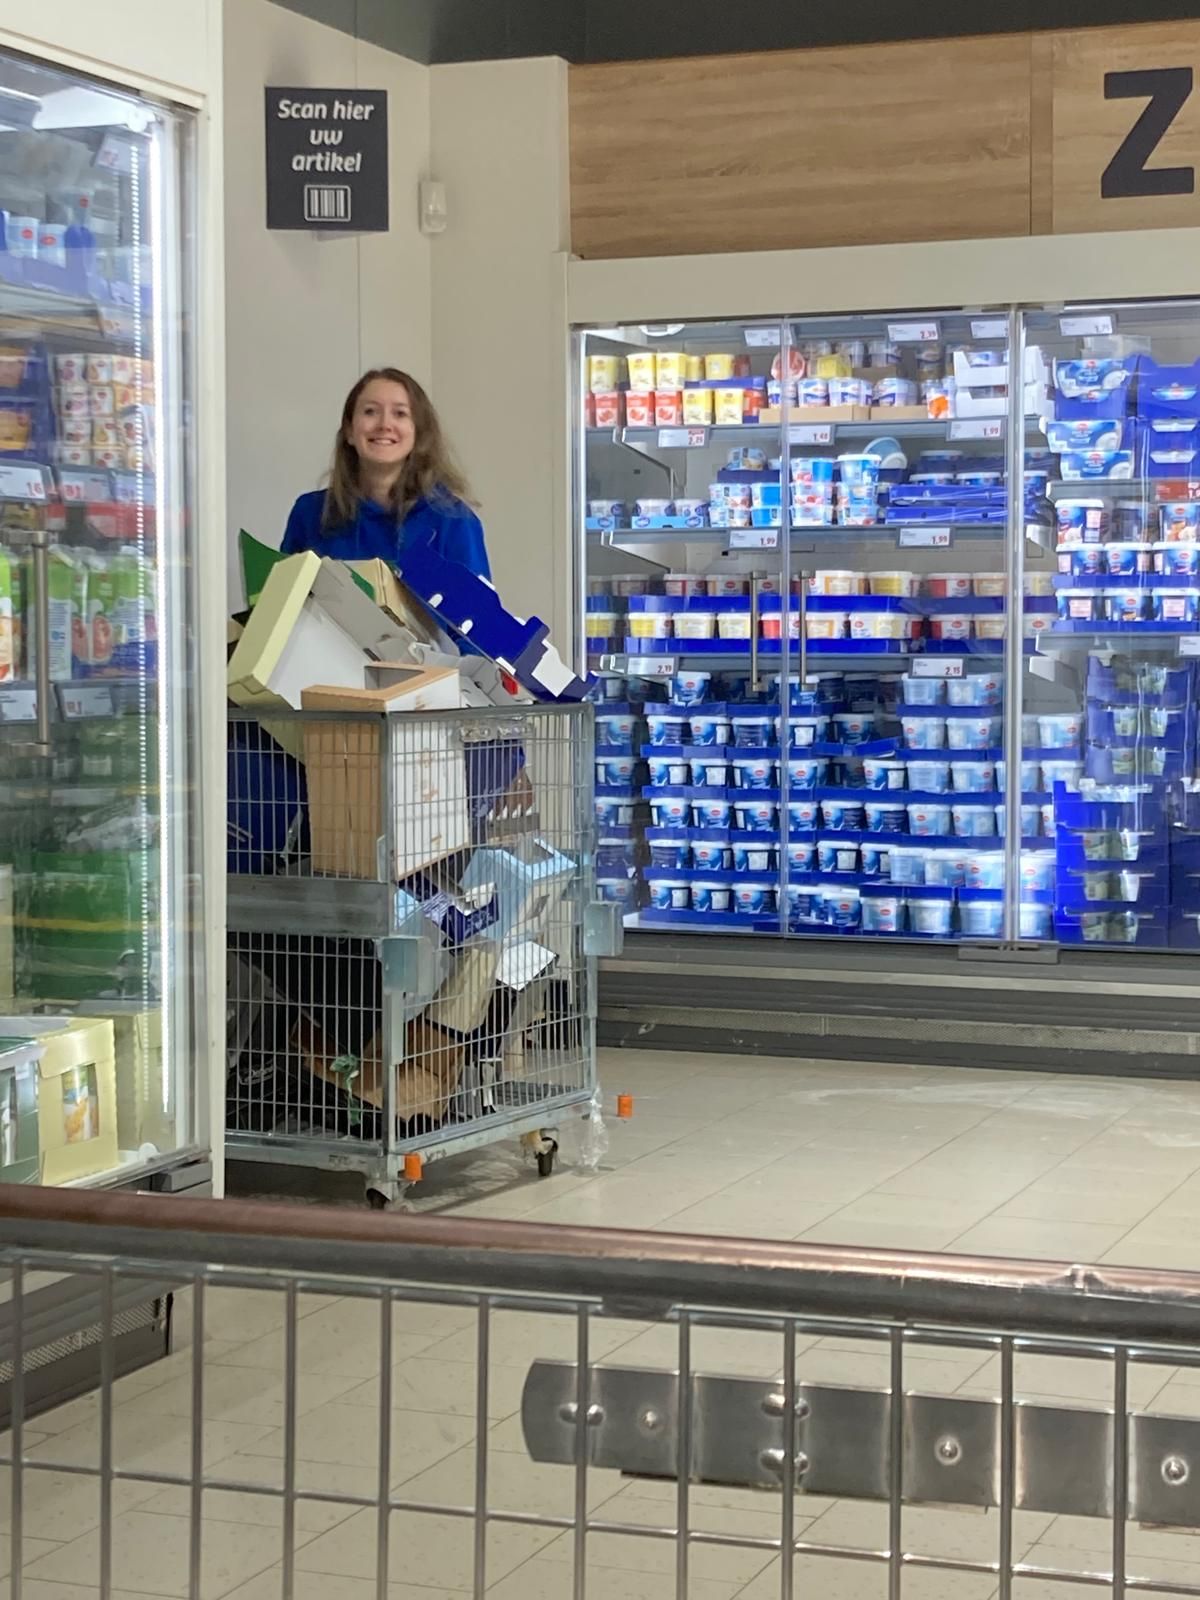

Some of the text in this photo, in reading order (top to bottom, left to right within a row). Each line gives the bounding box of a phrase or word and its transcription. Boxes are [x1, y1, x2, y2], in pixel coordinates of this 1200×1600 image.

[278, 99, 374, 120] Scan hier
[309, 129, 343, 145] uw
[1101, 67, 1194, 198] Z
[291, 152, 362, 172] artikel
